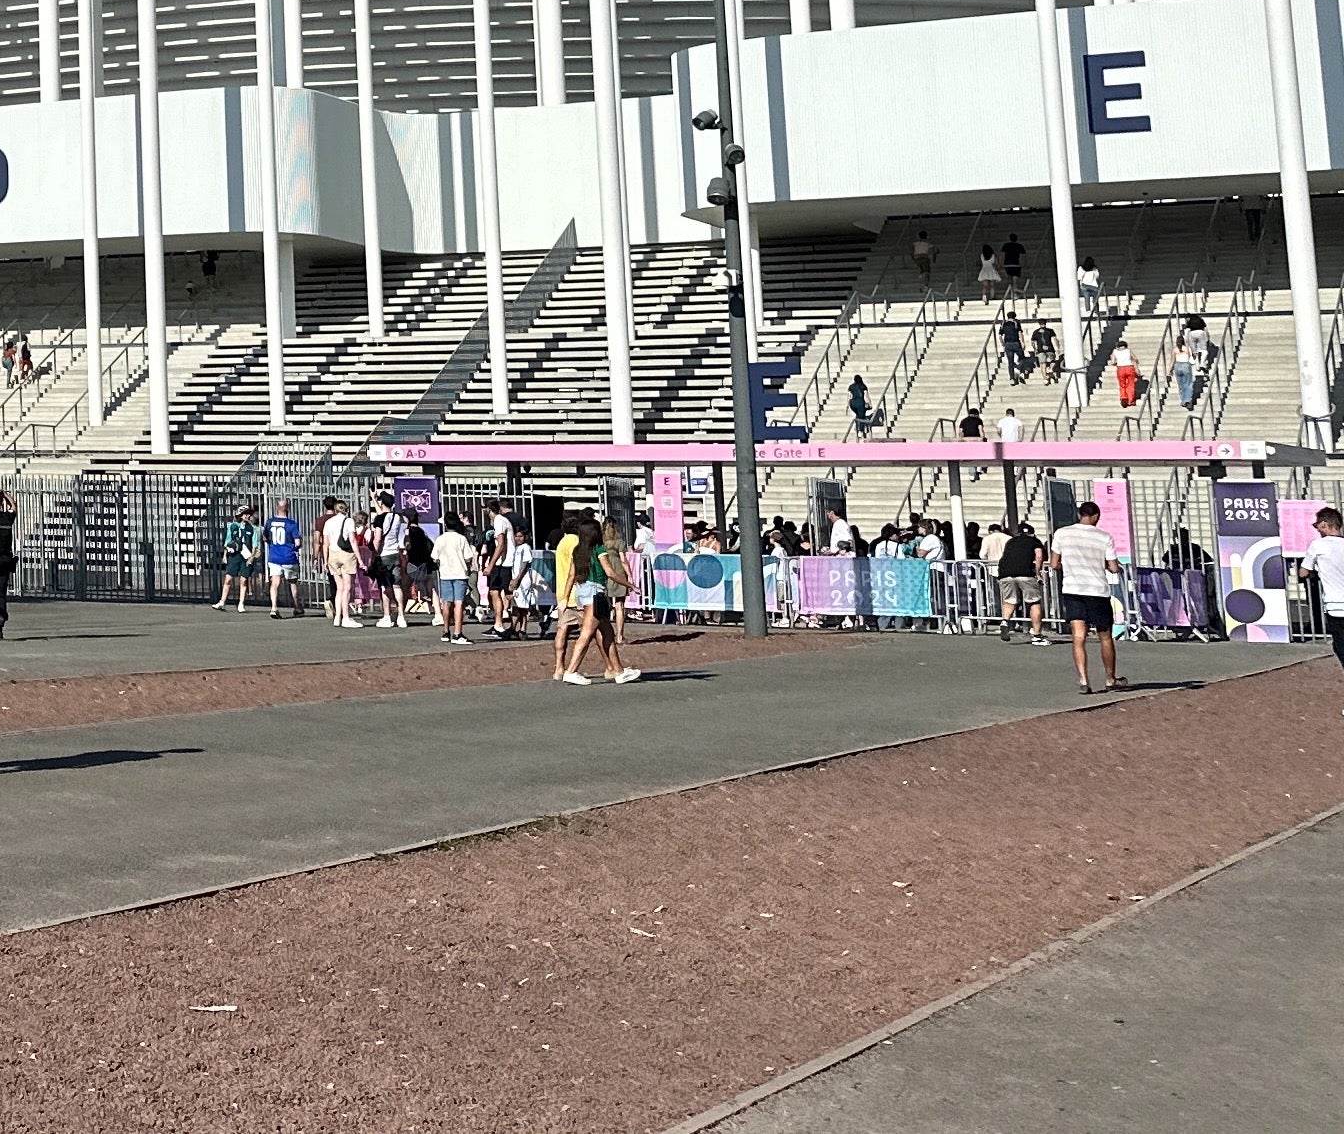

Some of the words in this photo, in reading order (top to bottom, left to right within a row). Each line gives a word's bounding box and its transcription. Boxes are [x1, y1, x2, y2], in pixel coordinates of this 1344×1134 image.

[1083, 50, 1151, 134] E
[747, 359, 809, 442] E
[774, 447, 803, 458] Gate
[818, 448, 826, 458] E
[1194, 446, 1212, 456] F-J
[664, 476, 670, 486] E
[1107, 485, 1114, 494] E
[1223, 497, 1269, 509] PARIS
[1224, 509, 1270, 521] 2024
[270, 526, 286, 545] 10
[829, 570, 897, 587] PARIS
[831, 589, 898, 607] 2024
